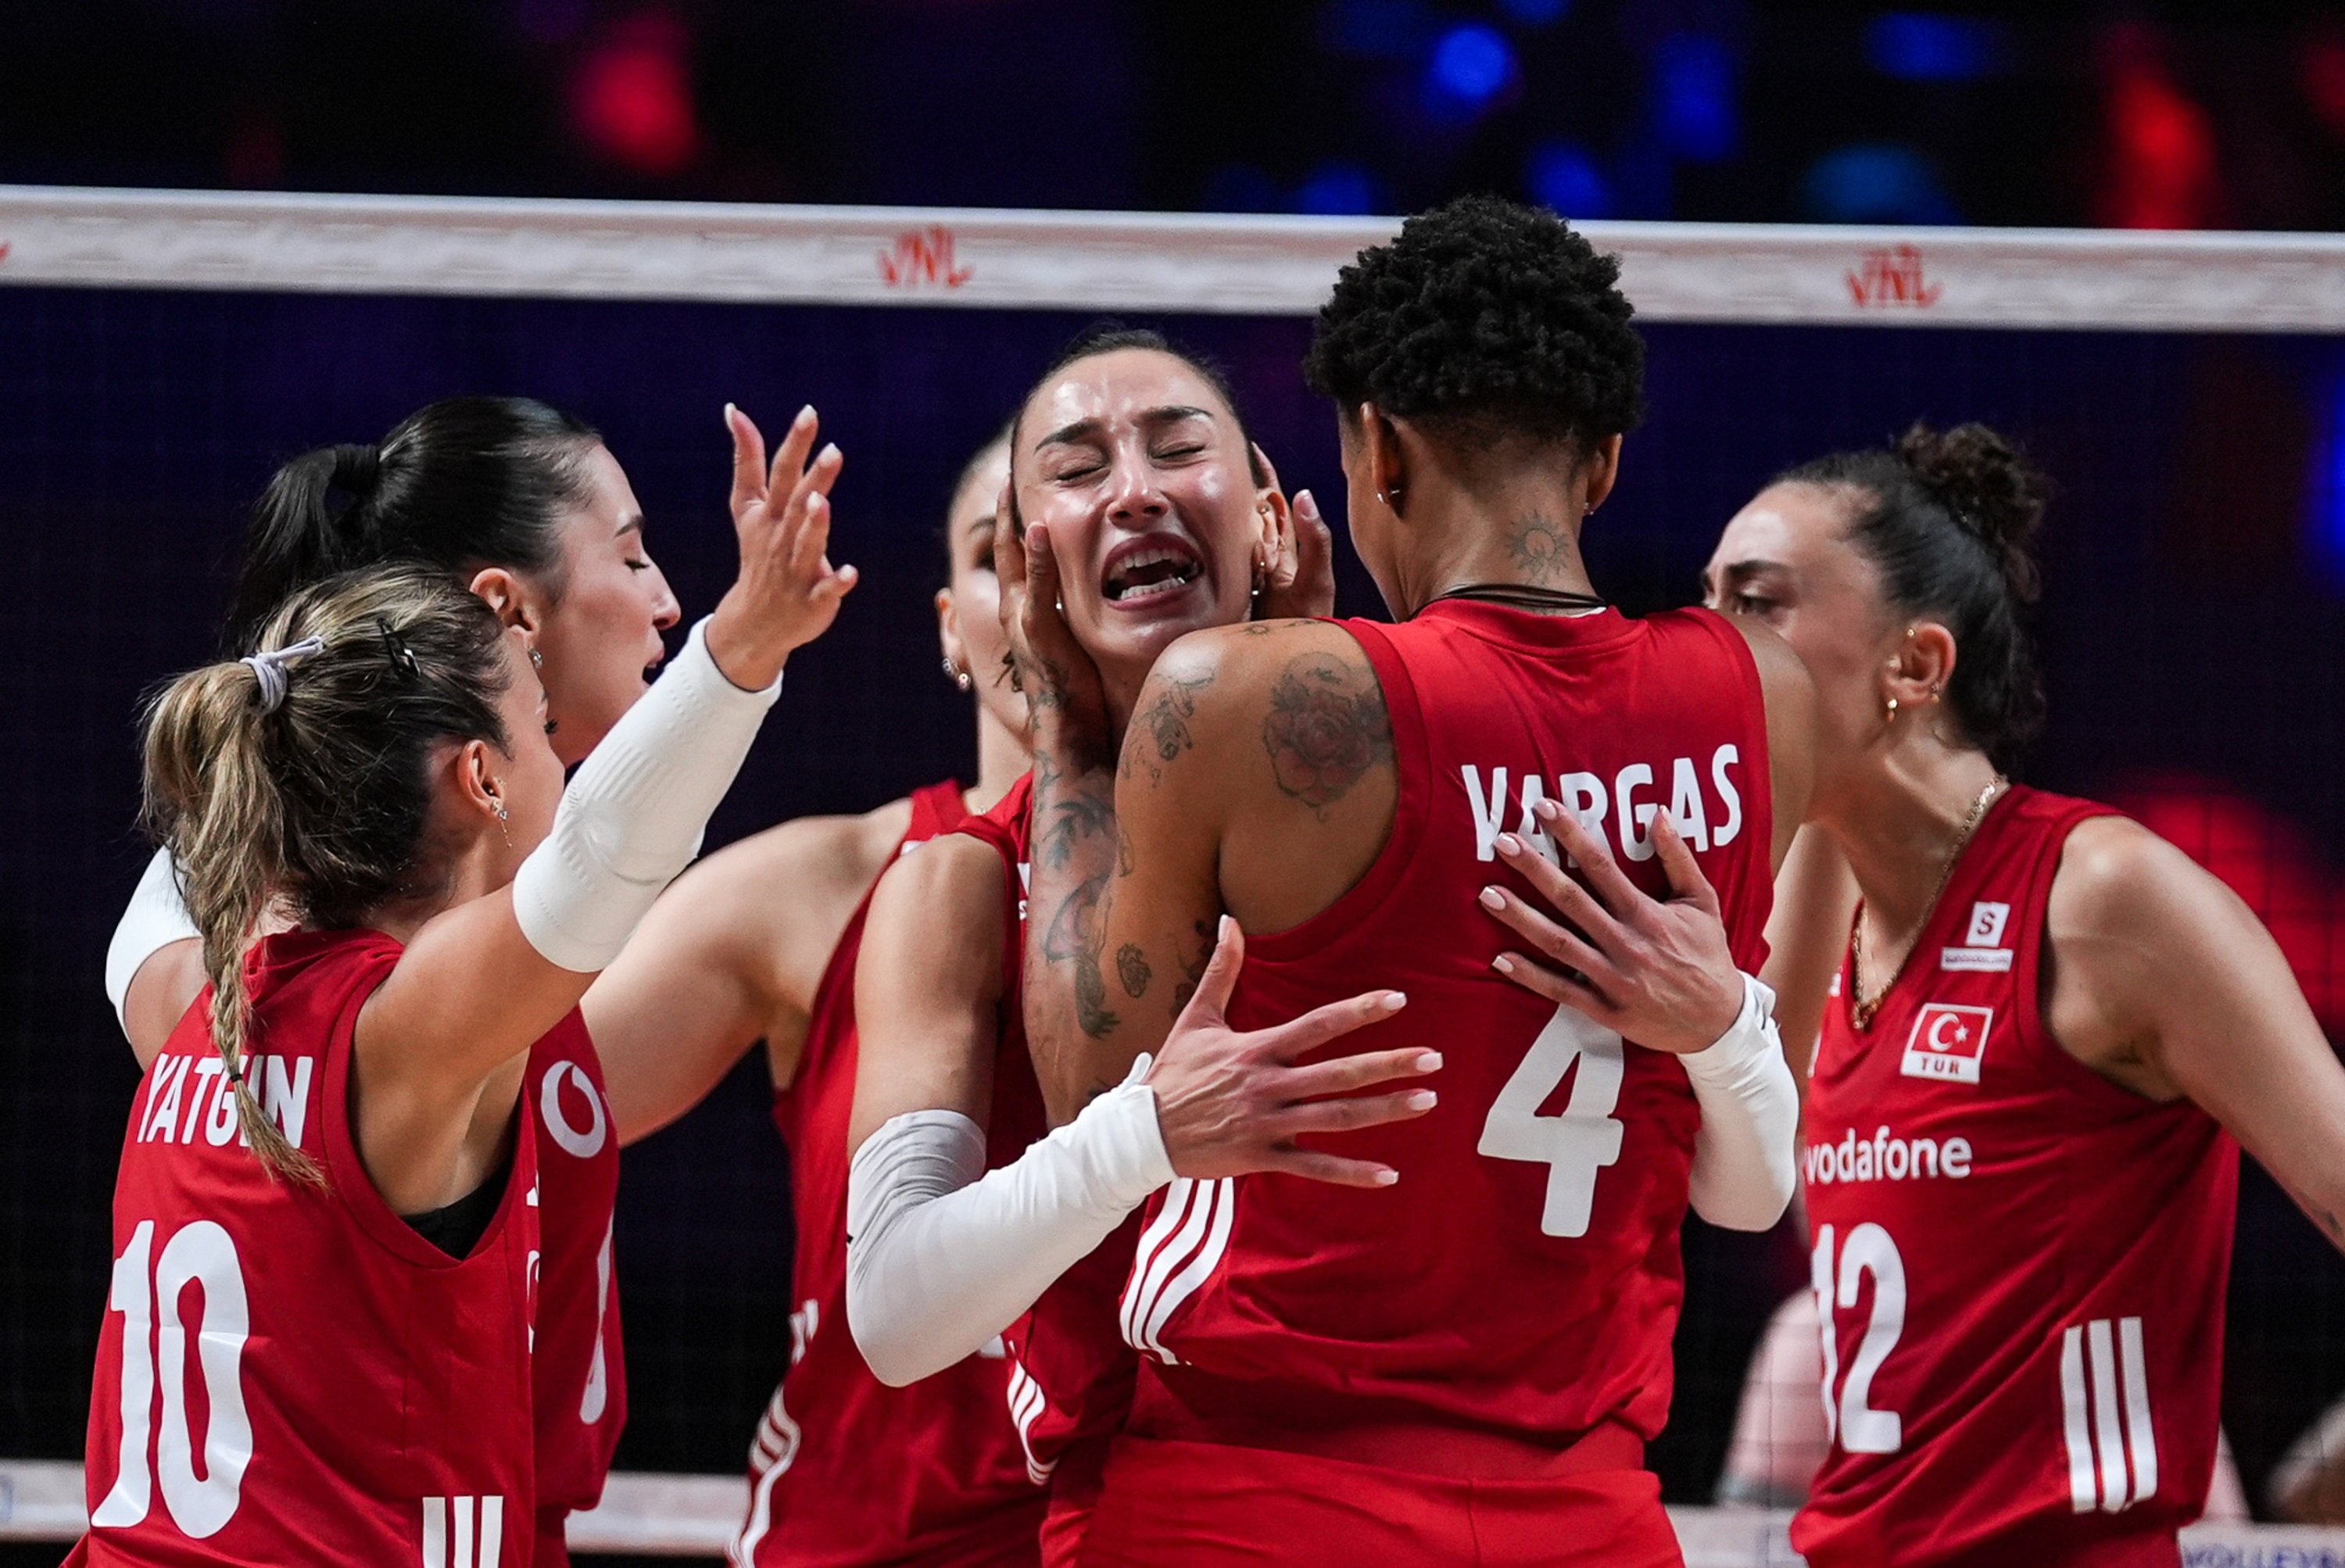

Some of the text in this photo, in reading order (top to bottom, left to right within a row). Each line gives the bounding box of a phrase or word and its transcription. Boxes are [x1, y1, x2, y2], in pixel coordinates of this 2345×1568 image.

[879, 225, 975, 288] VNL
[1846, 244, 1945, 308] VNL
[1461, 743, 1742, 869] VARGAS
[1977, 911, 1996, 936] S
[1921, 1057, 1960, 1075] TUR
[1477, 1001, 1624, 1237] 4
[1806, 1125, 1972, 1185] vodafone
[1811, 1222, 1906, 1454] 12
[91, 1219, 253, 1539] 10
